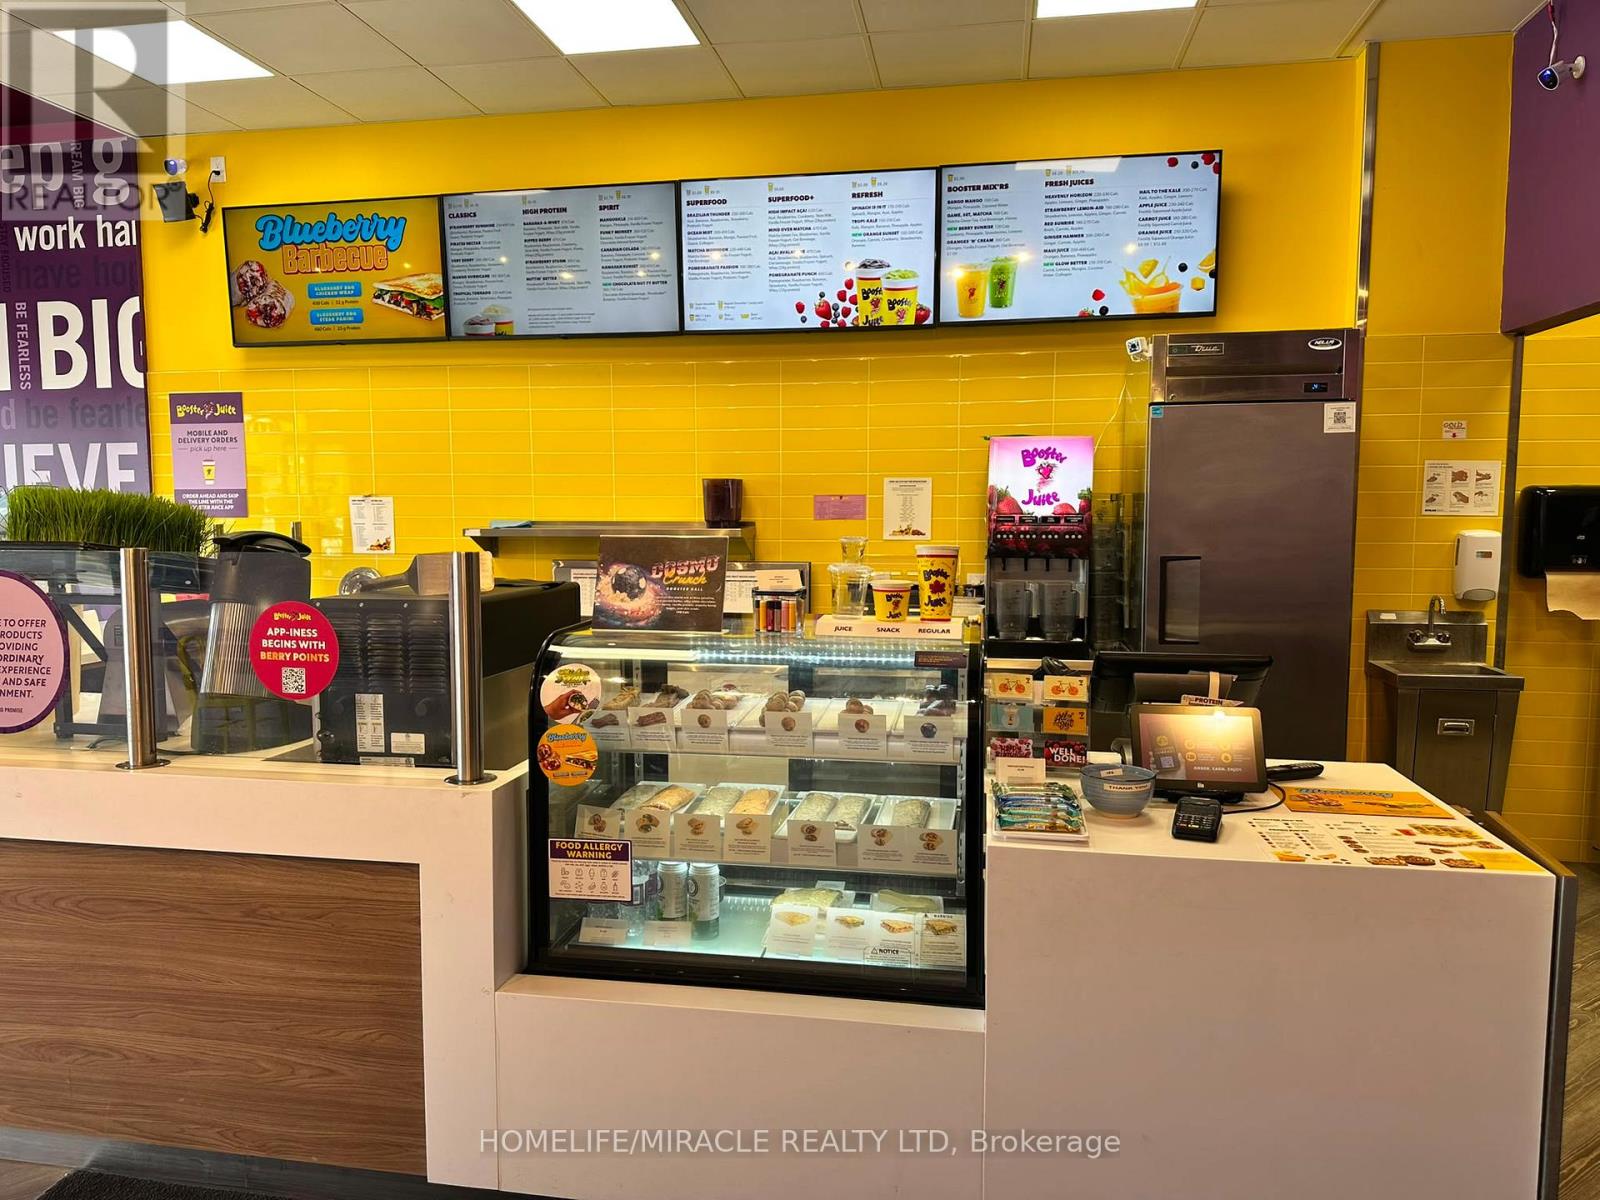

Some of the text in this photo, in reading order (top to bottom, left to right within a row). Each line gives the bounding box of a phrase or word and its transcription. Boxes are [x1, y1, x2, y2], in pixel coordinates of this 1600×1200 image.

[1045, 178, 1095, 188] FRESH JUICES
[947, 184, 981, 193] BOOSTER
[852, 190, 883, 199] REFRESH
[686, 198, 727, 207] SUPERFOOD
[598, 204, 620, 212] SPIRIT
[448, 211, 477, 219] CLASSICS
[14, 216, 86, 252] work
[255, 212, 407, 252] Blueberry
[281, 243, 389, 275] Barbecue
[15, 302, 31, 391] BE FEARLESS
[187, 429, 212, 437] MOBILE
[1021, 446, 1068, 468] Booster
[1021, 488, 1061, 506] Juice
[651, 555, 720, 578] COSMO
[4, 619, 47, 628] TO OFFER
[267, 627, 318, 638] APP-INESS
[261, 639, 326, 650] BEGINS WITH
[260, 651, 330, 663] BERRY POINTS
[2, 677, 47, 687] AND SAFE
[1194, 697, 1223, 706] PROTEIN
[1049, 747, 1073, 756] WELL
[1054, 754, 1086, 764] DONE!
[555, 841, 623, 852] FOOD ALLERGY
[566, 850, 612, 860] WARNING
